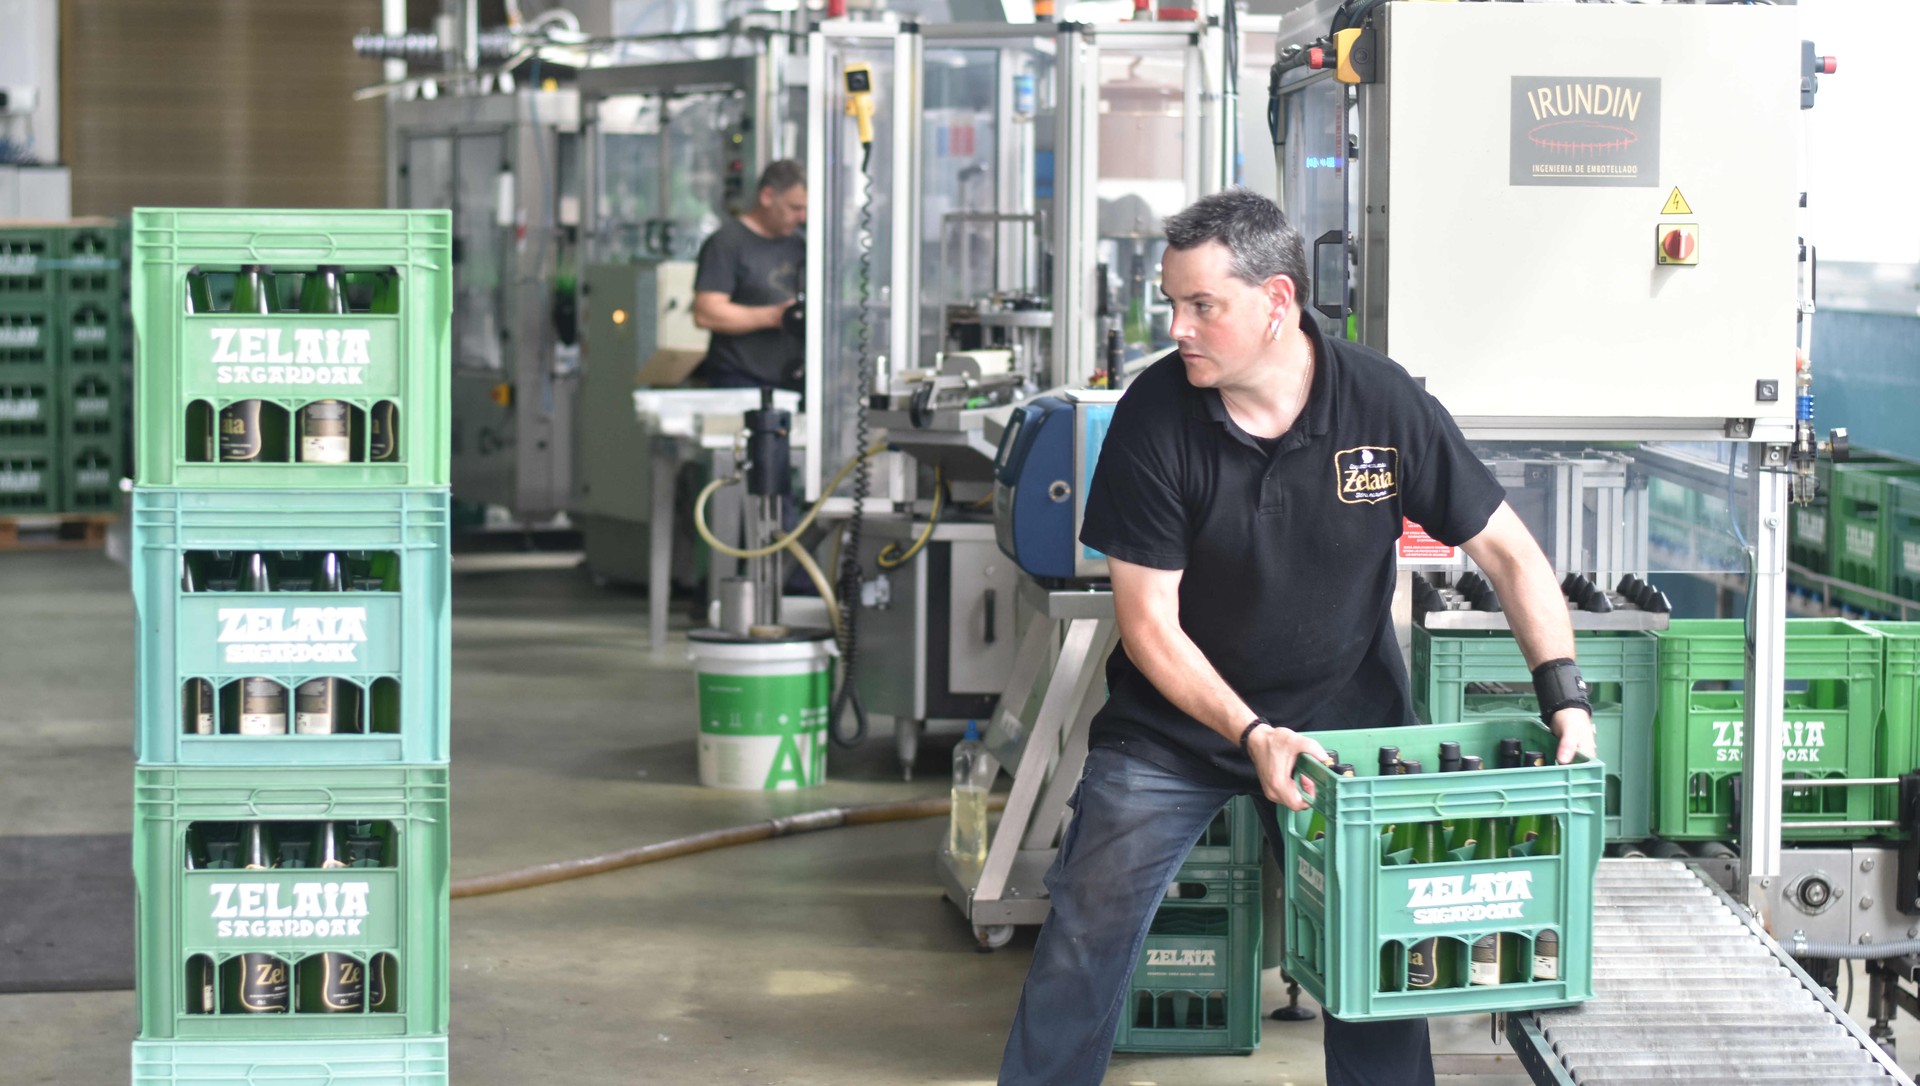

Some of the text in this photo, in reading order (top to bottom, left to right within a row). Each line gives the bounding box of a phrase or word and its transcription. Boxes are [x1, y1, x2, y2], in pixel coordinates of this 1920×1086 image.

[1528, 84, 1642, 121] IRUNDIN
[1532, 164, 1638, 174] INGENIERIA DE EMBOTELLADO
[217, 365, 363, 385] SAGARDOAK
[1343, 467, 1395, 493] Zelaia
[1413, 901, 1524, 925] SAGARDOAK
[217, 918, 363, 938] SAGARDOAK
